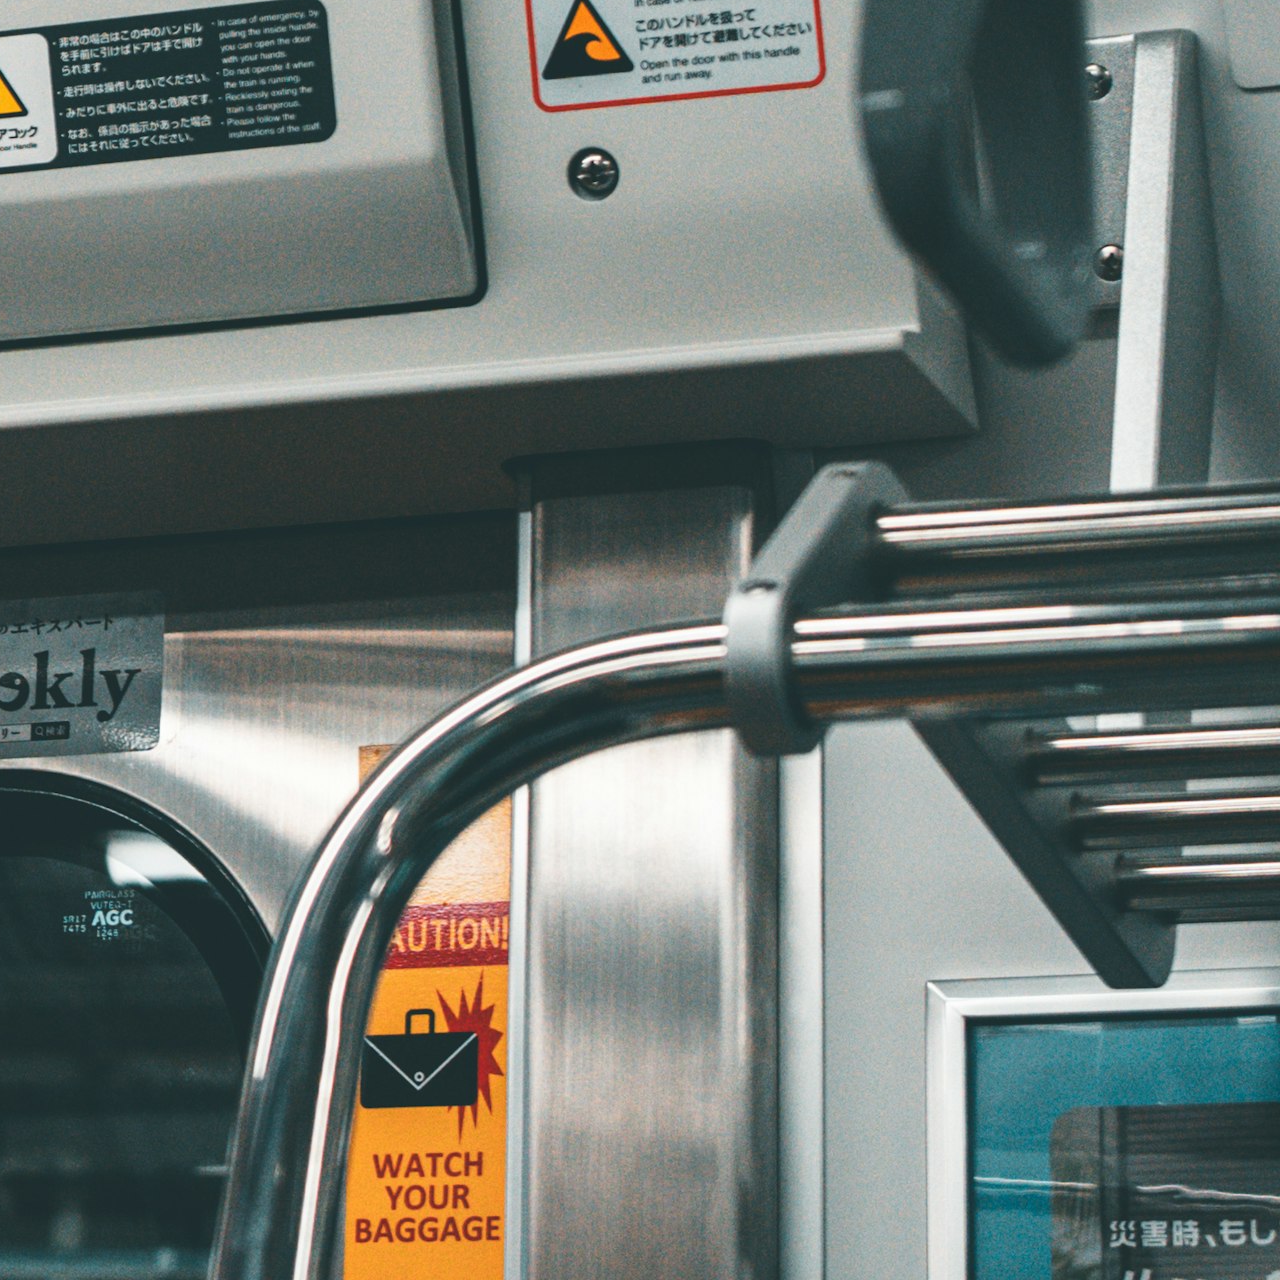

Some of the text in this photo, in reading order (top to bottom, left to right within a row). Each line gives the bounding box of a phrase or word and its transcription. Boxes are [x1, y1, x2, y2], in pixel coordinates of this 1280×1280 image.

[635, 8, 757, 33] このハンドルを扱って
[638, 22, 813, 51] ドアを開けて避難してください
[639, 46, 800, 71] Open the door with this handle
[641, 73, 661, 84] and
[664, 72, 682, 81] run
[91, 909, 134, 927] AGC
[372, 1151, 485, 1179] WATCH
[385, 1183, 471, 1211] YOUR
[354, 1214, 501, 1244] BAGGAGE
